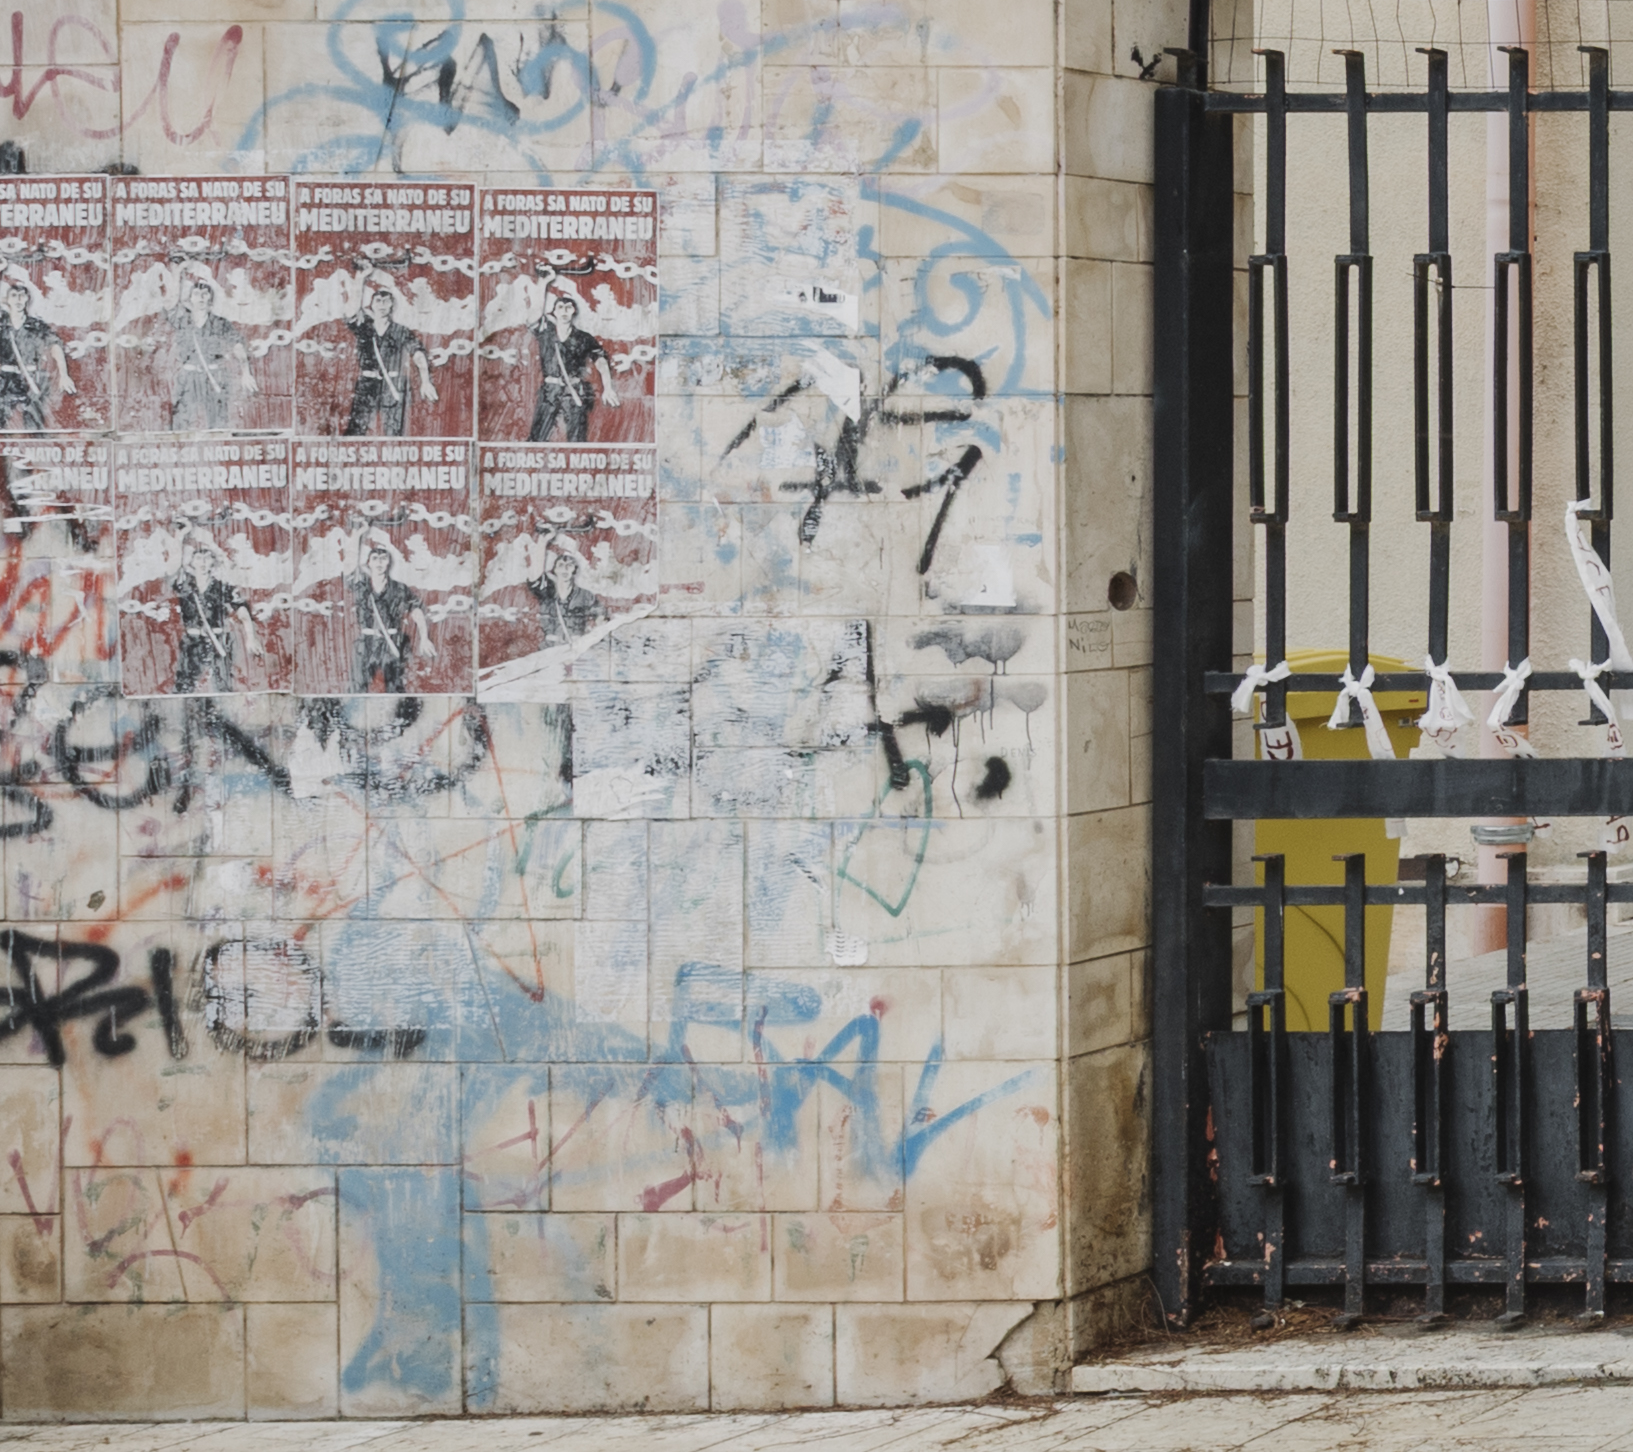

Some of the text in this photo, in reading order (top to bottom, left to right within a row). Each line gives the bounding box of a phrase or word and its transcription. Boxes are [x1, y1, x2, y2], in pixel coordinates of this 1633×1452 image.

[20, 182, 57, 199] NATO
[61, 182, 80, 199] DE
[83, 182, 103, 199] SU
[116, 181, 286, 199] A FORAS SA NATO DE SU
[300, 188, 470, 206] A FORAS SA NATO DE SU
[116, 201, 287, 227] MEDITERRANEU
[483, 195, 652, 214] A FORAS SA NATO DE SU
[300, 207, 471, 234] MEDITERRANEU
[483, 215, 653, 240] MEDITERRANEU
[132, 447, 177, 464] FORAS
[180, 447, 199, 463] SA
[203, 444, 240, 462] NATO
[243, 444, 263, 461] DE
[266, 443, 286, 461] SU
[295, 446, 465, 463] A FORAS SA NATO DE SU
[484, 452, 651, 470] A FORAS SA NATO DE SU
[118, 464, 287, 493] MEDITERRANEU
[295, 466, 466, 492] MEDITERRANEU
[483, 471, 653, 497] MEDITERRANEU
